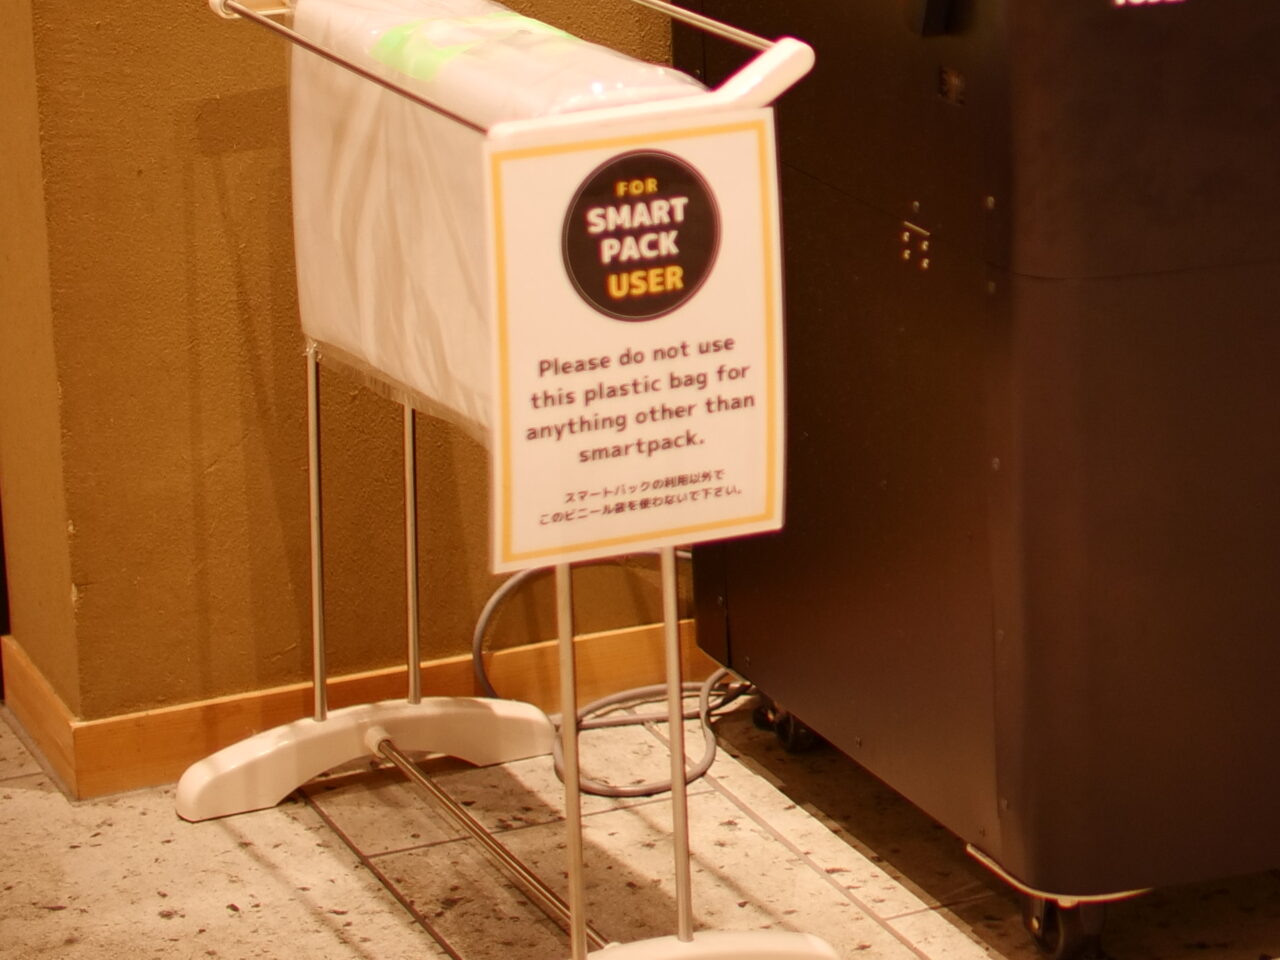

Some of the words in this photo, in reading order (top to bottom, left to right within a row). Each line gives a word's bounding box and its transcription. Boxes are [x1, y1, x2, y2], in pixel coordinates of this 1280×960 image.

[615, 177, 659, 198] FOR
[586, 196, 689, 235] SMART
[600, 230, 680, 265] PACK
[607, 265, 685, 300] USER
[538, 349, 612, 378] Please
[618, 347, 646, 368] do
[652, 341, 690, 365] not
[697, 336, 737, 357] use
[530, 385, 577, 410] this
[583, 375, 663, 407] plastic
[668, 368, 710, 394] bag
[716, 362, 752, 385] for
[525, 412, 628, 443] anything
[635, 402, 698, 427] other
[704, 392, 757, 417] than
[578, 430, 706, 465] smartpack.
